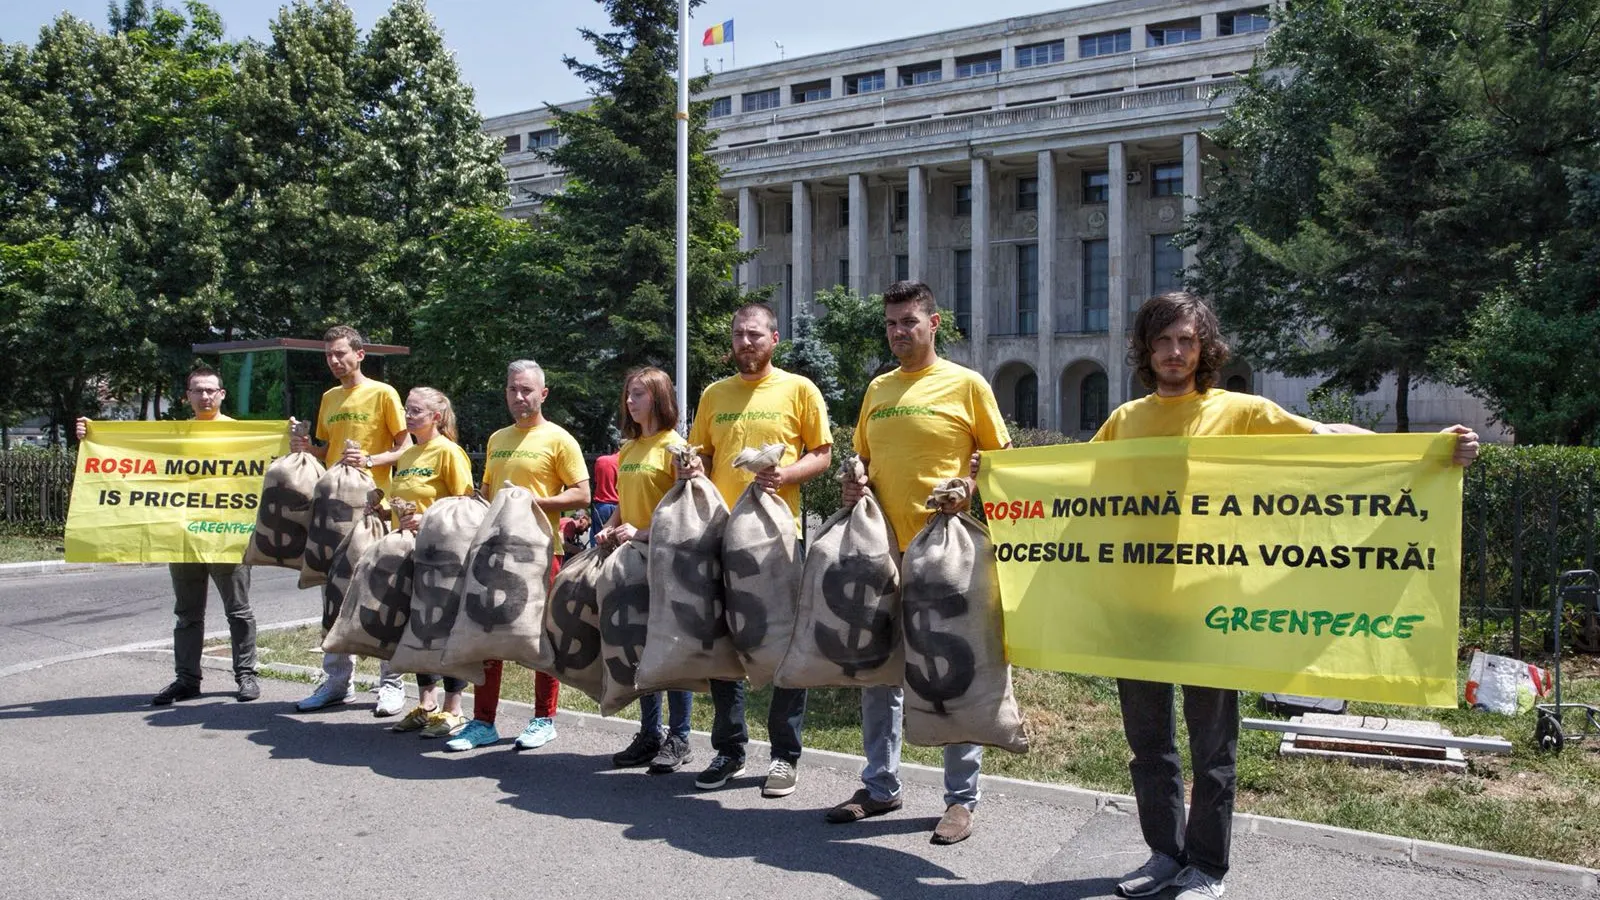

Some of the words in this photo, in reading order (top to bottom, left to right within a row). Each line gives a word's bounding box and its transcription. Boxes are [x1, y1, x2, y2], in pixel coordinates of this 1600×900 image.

[715, 411, 781, 424] GREENPEACE
[84, 457, 158, 478] ROȘIA
[165, 456, 279, 476] MONTAN
[99, 490, 122, 506] IS
[129, 491, 258, 509] PRICELESS
[984, 500, 1045, 526] ROȘIA
[1052, 490, 1182, 518] MONTANĂ
[1192, 495, 1209, 515] E
[1219, 495, 1242, 516] A
[1252, 488, 1429, 522] NOASTRĂ,
[187, 521, 256, 534] GREENPEA
[1099, 543, 1114, 562] E
[1123, 542, 1249, 567] MIZERIA
[1259, 542, 1436, 570] VOASTRĂ!
[1204, 605, 1426, 639] GREENPEACE
